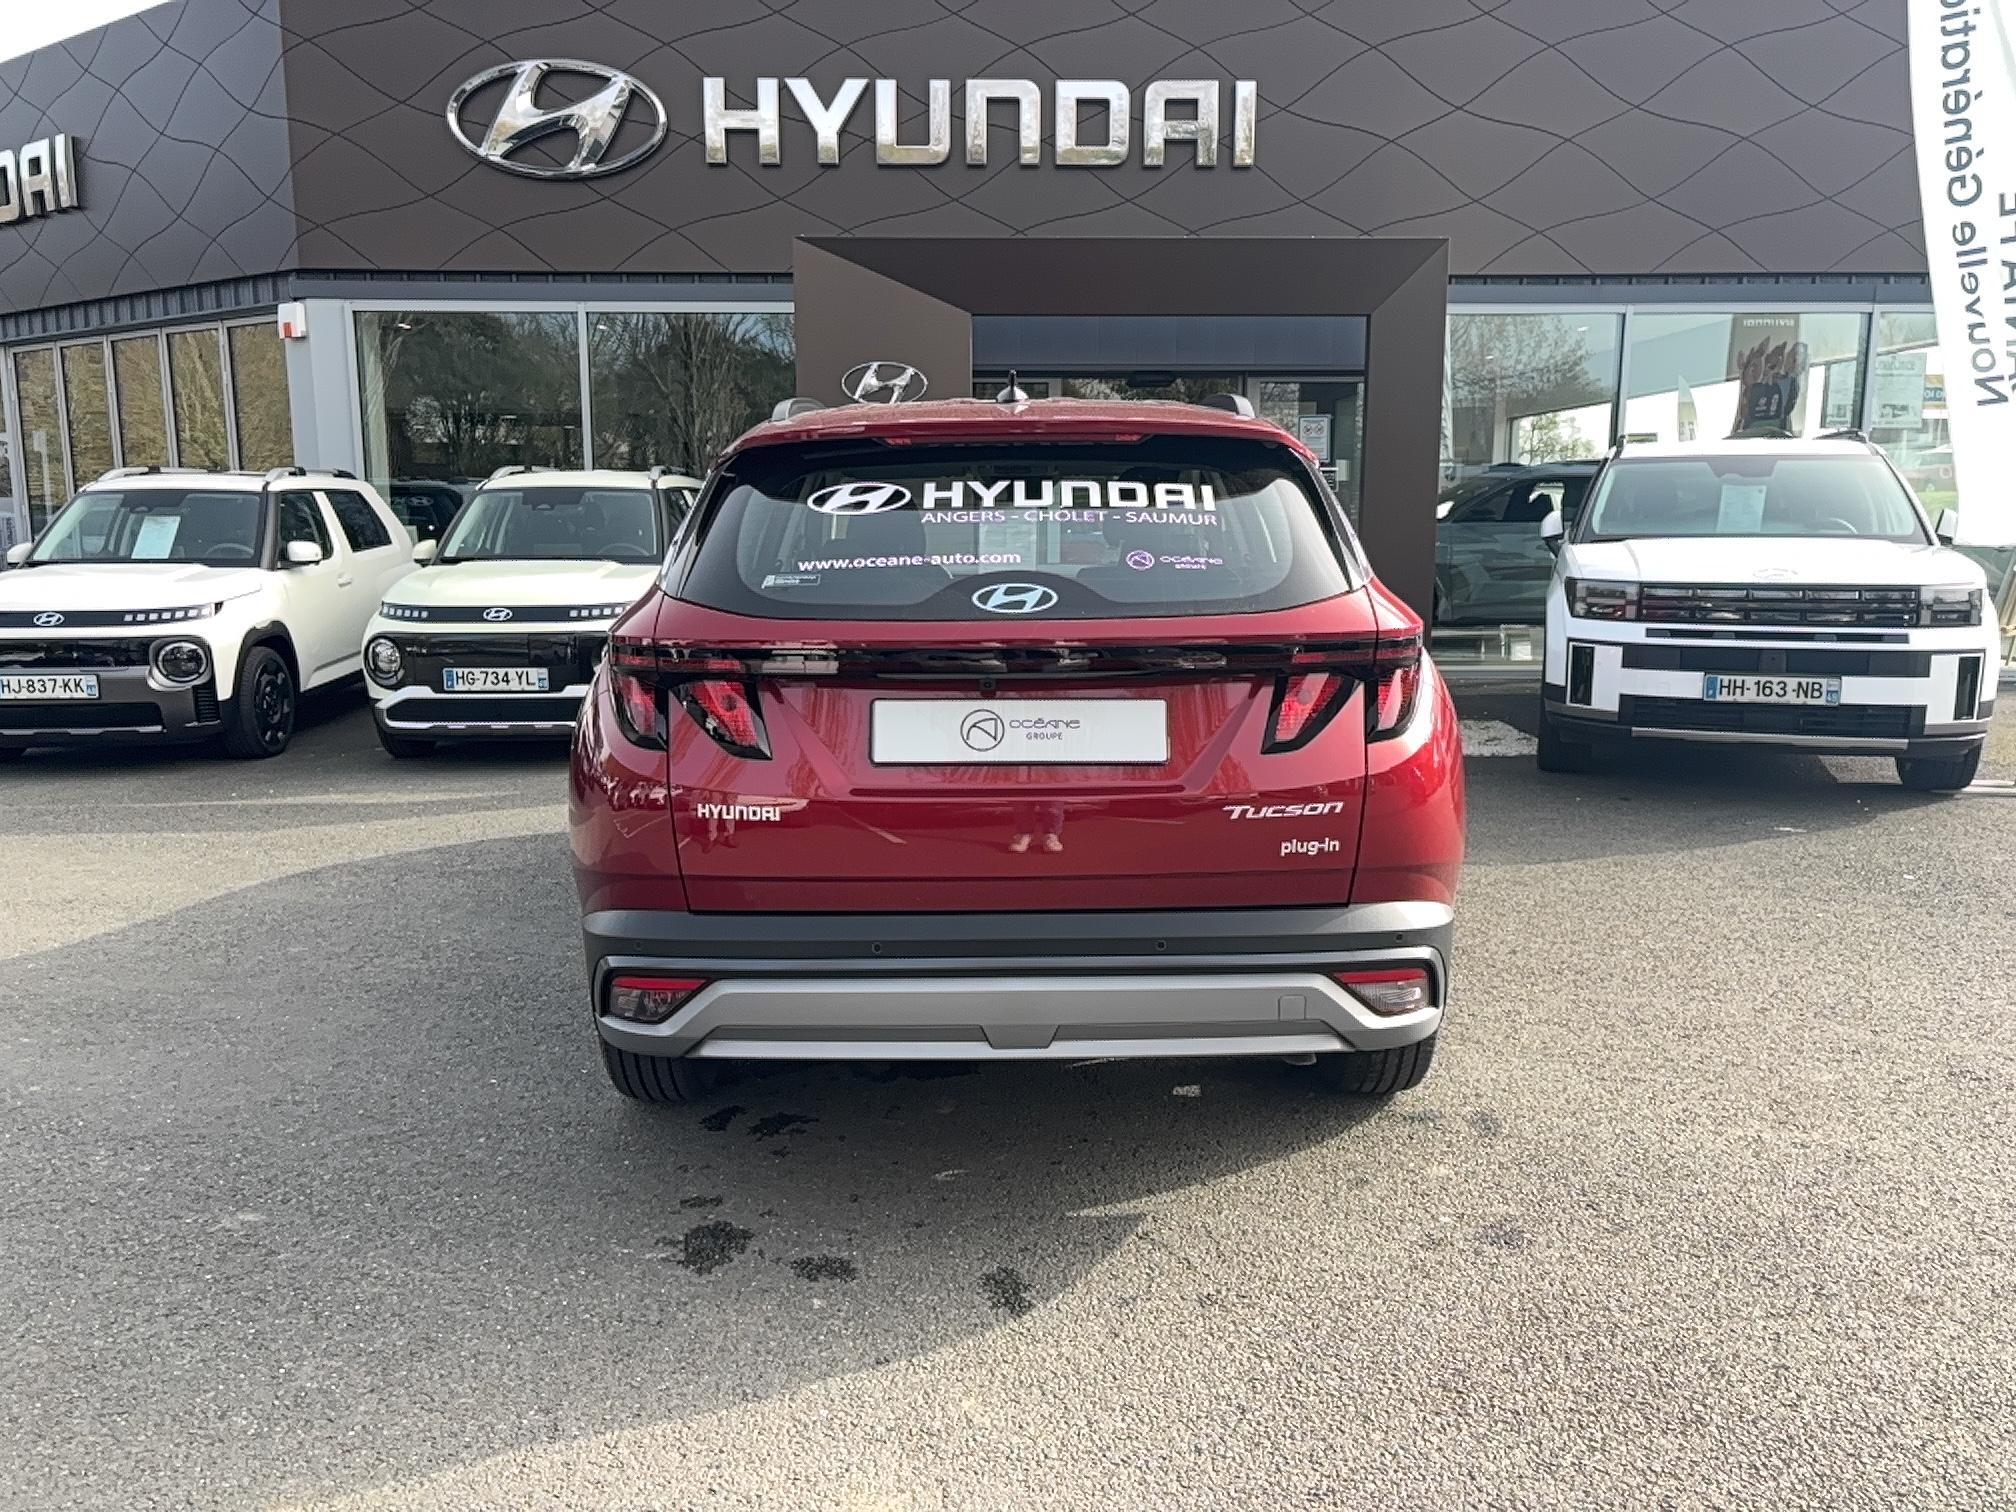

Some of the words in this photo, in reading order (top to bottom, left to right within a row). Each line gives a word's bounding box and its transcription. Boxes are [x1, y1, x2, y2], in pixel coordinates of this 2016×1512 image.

[702, 76, 1258, 168] HYUNDAI
[922, 480, 1217, 512] HYUNDAI
[921, 510, 1006, 523] ANGERS
[1024, 509, 1108, 523] CHOLET
[1125, 511, 1218, 526] SAUMUR
[798, 551, 1022, 571] www.oceane-auto.com
[1, 678, 84, 694] HJ-837-KK
[455, 670, 536, 686] HG-734-YL
[1719, 678, 1823, 699] HH-163-NB
[1025, 731, 1063, 741] GROUPE
[697, 803, 780, 822] HYUNDAI
[1279, 836, 1340, 857] plug-in
